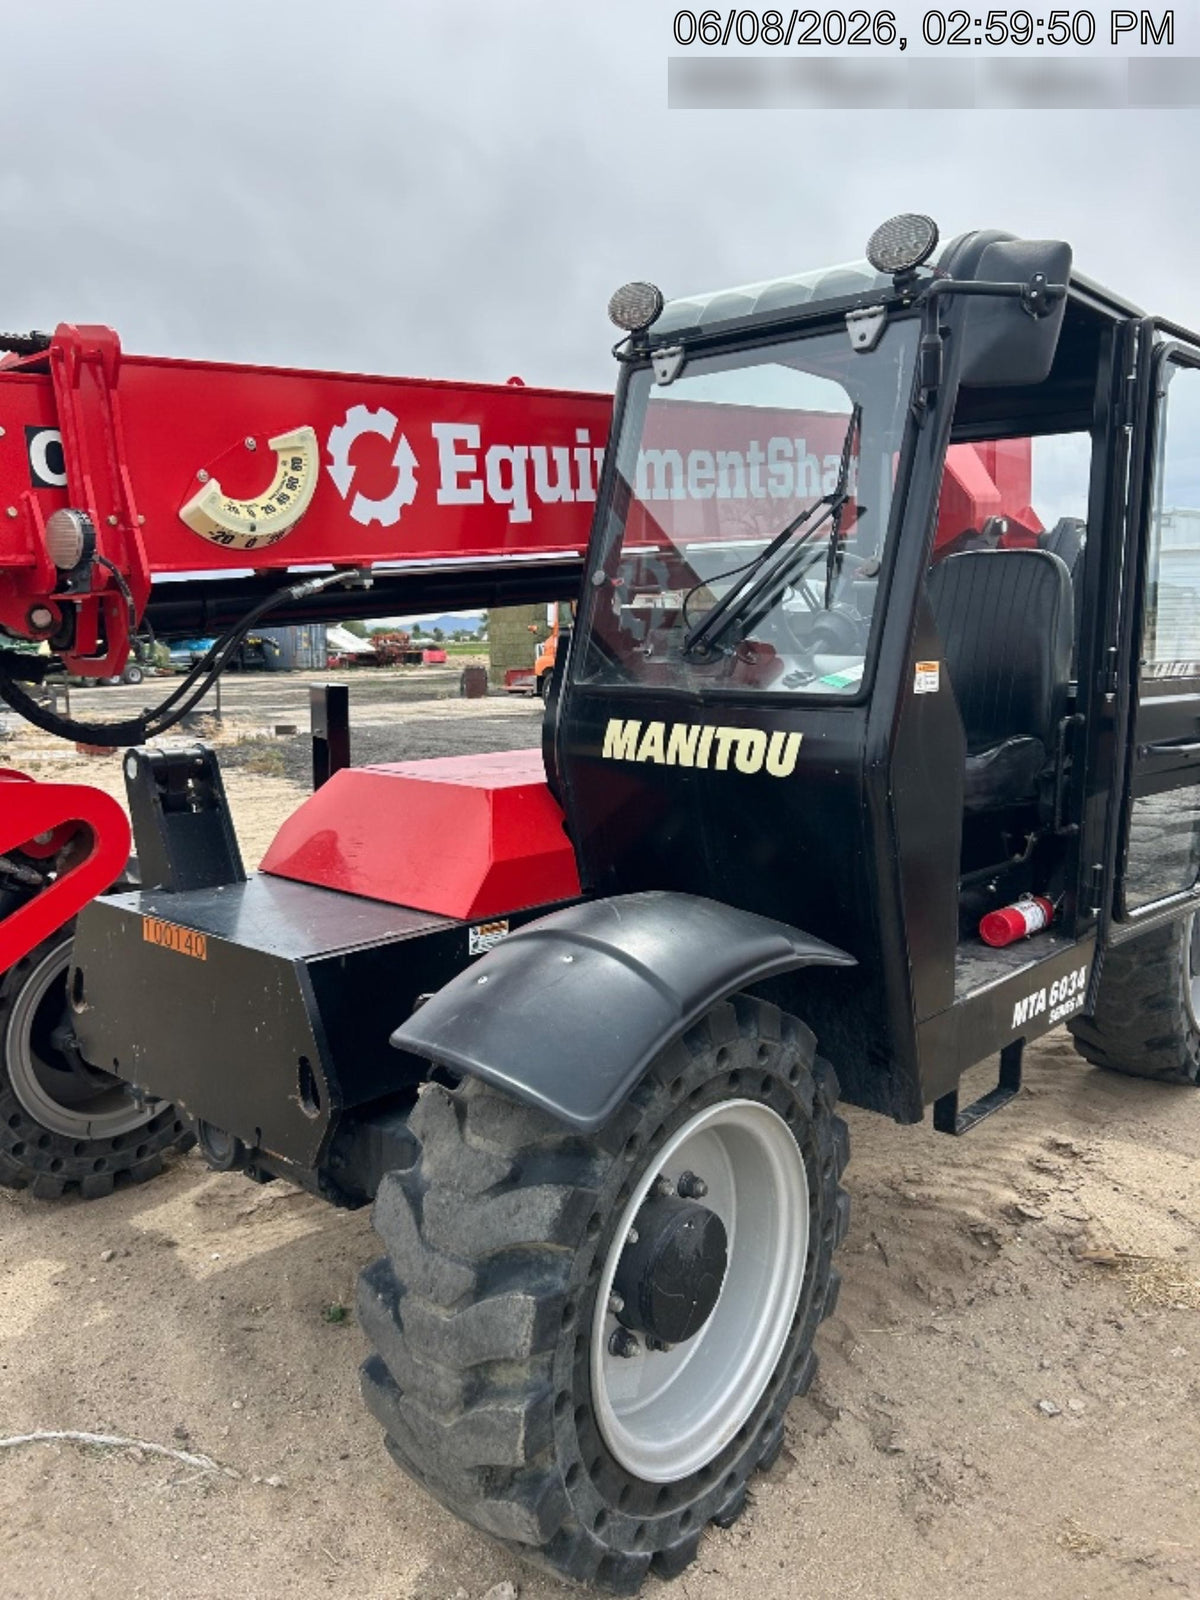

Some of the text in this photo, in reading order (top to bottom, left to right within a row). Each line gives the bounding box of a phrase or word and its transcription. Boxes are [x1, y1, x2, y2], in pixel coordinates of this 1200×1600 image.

[432, 422, 858, 523] EquimentSha
[208, 530, 235, 545] -20
[244, 537, 258, 549] 0
[602, 718, 803, 777] MANITOU
[145, 919, 205, 957] 100140
[1011, 965, 1087, 1029] MTA 6034
